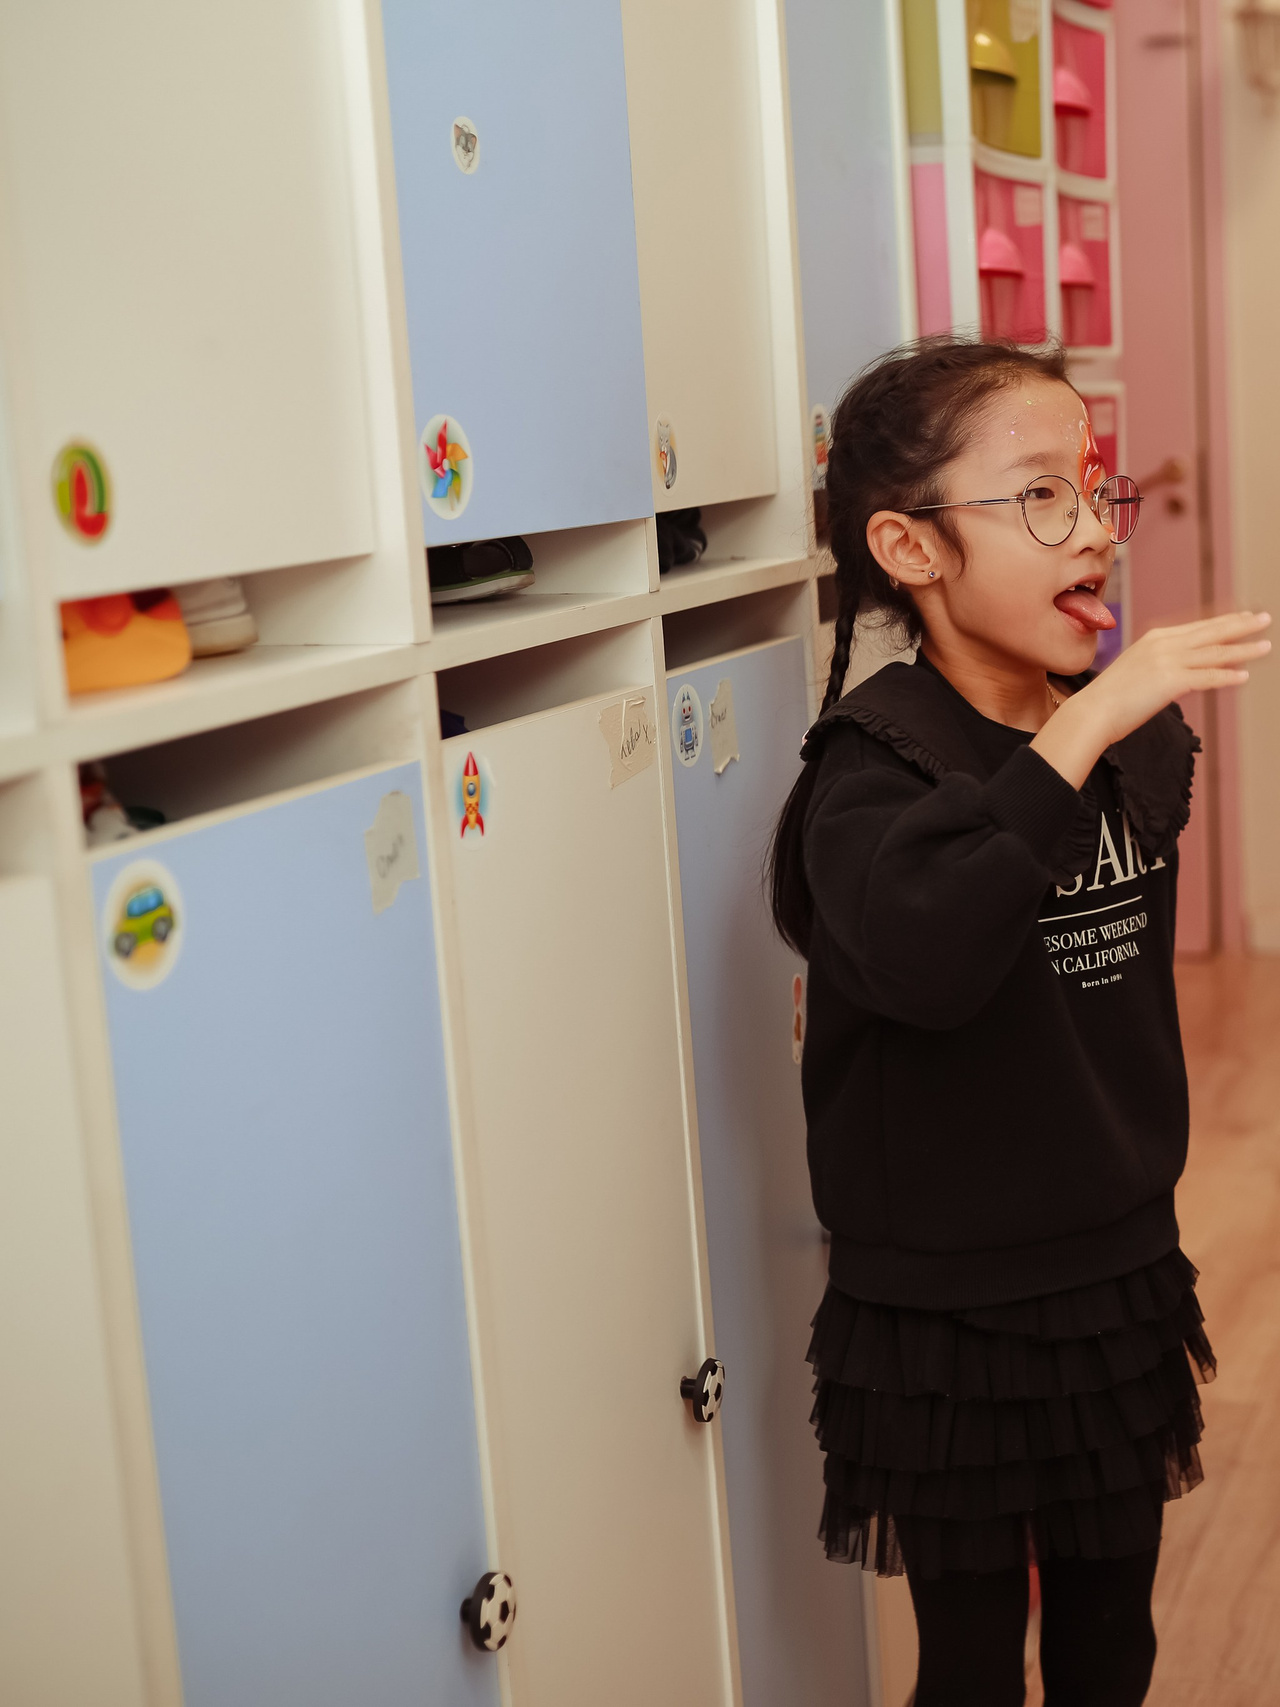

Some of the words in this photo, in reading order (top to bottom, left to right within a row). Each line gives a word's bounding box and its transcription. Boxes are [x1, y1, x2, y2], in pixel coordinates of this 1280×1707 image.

[1099, 912, 1148, 941] WEEKEND
[1062, 941, 1140, 974] CALIFORNIA
[1081, 981, 1100, 989] Born
